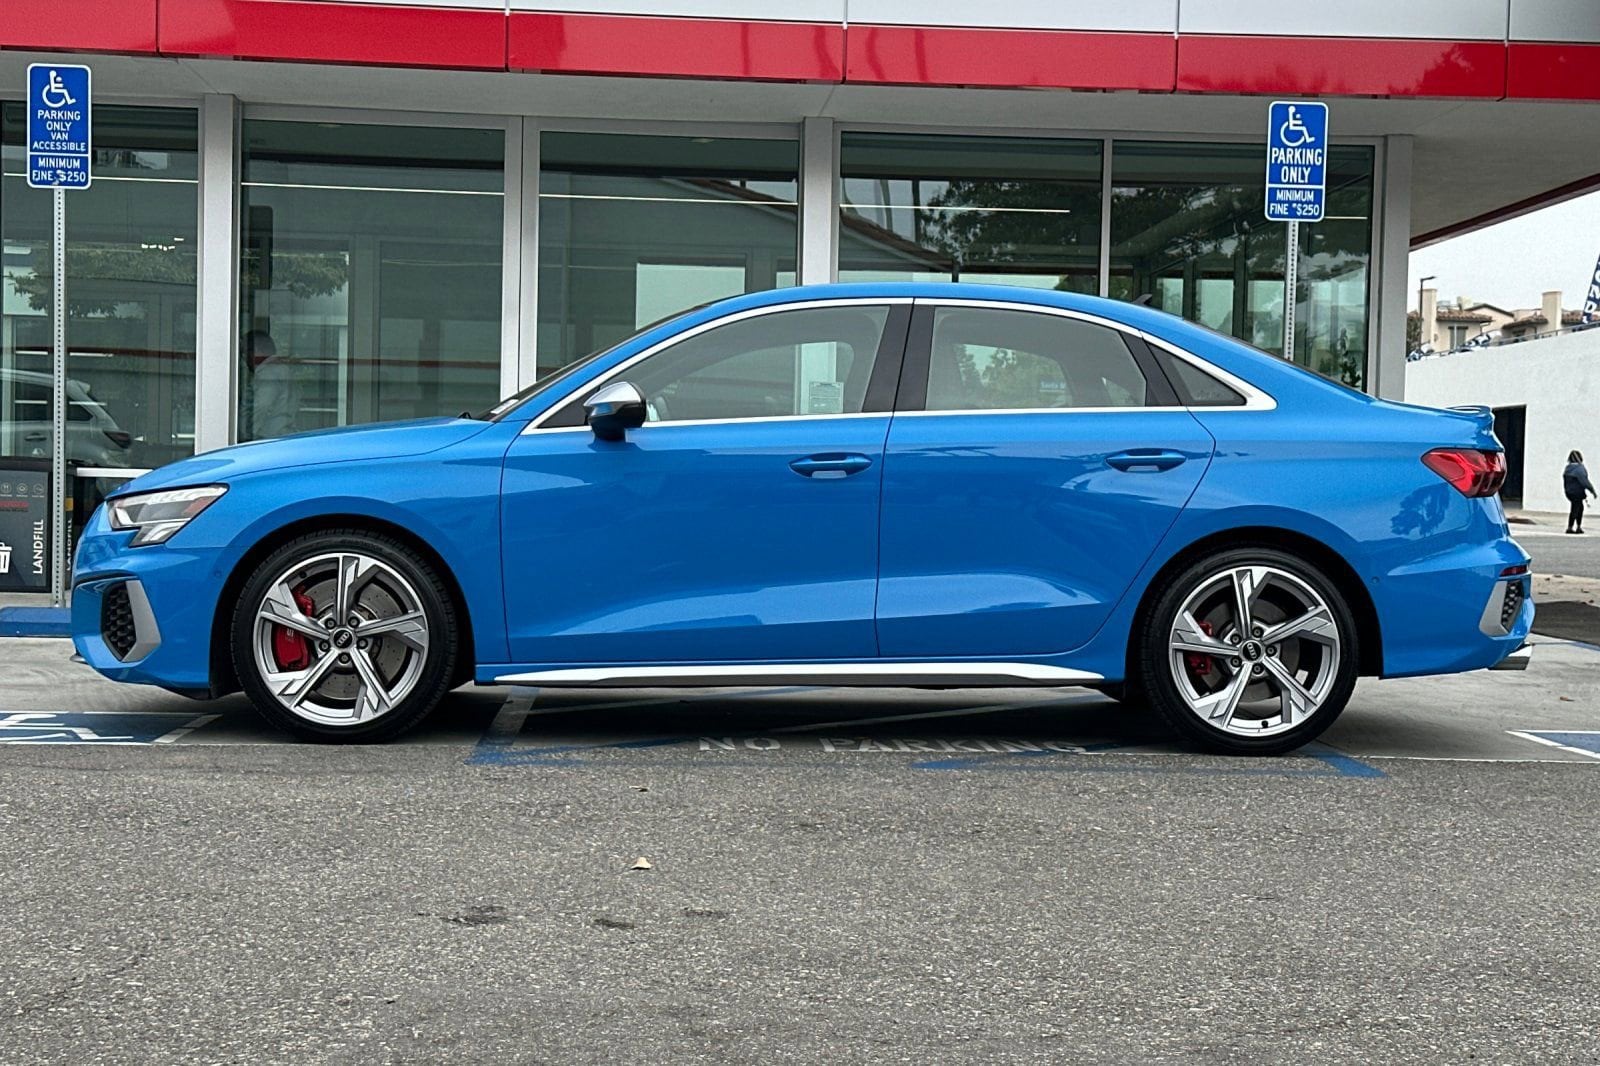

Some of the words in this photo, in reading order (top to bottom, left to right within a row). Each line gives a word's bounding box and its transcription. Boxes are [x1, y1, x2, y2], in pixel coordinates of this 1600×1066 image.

[37, 109, 81, 121] PARKING
[46, 120, 72, 131] ONLY
[50, 131, 69, 140] VAN
[32, 140, 86, 152] ACCESSIBLE
[1271, 147, 1323, 166] PARKING
[38, 157, 81, 169] MINIMUM
[32, 169, 54, 181] FINE
[1281, 166, 1311, 184] ONLY
[1276, 189, 1315, 202] MINIMUM
[1269, 203, 1289, 215] FINE
[1296, 203, 1320, 216] $250
[32, 519, 44, 574] LANDFILL
[699, 736, 782, 751] NO
[818, 738, 1087, 753] PARKING
